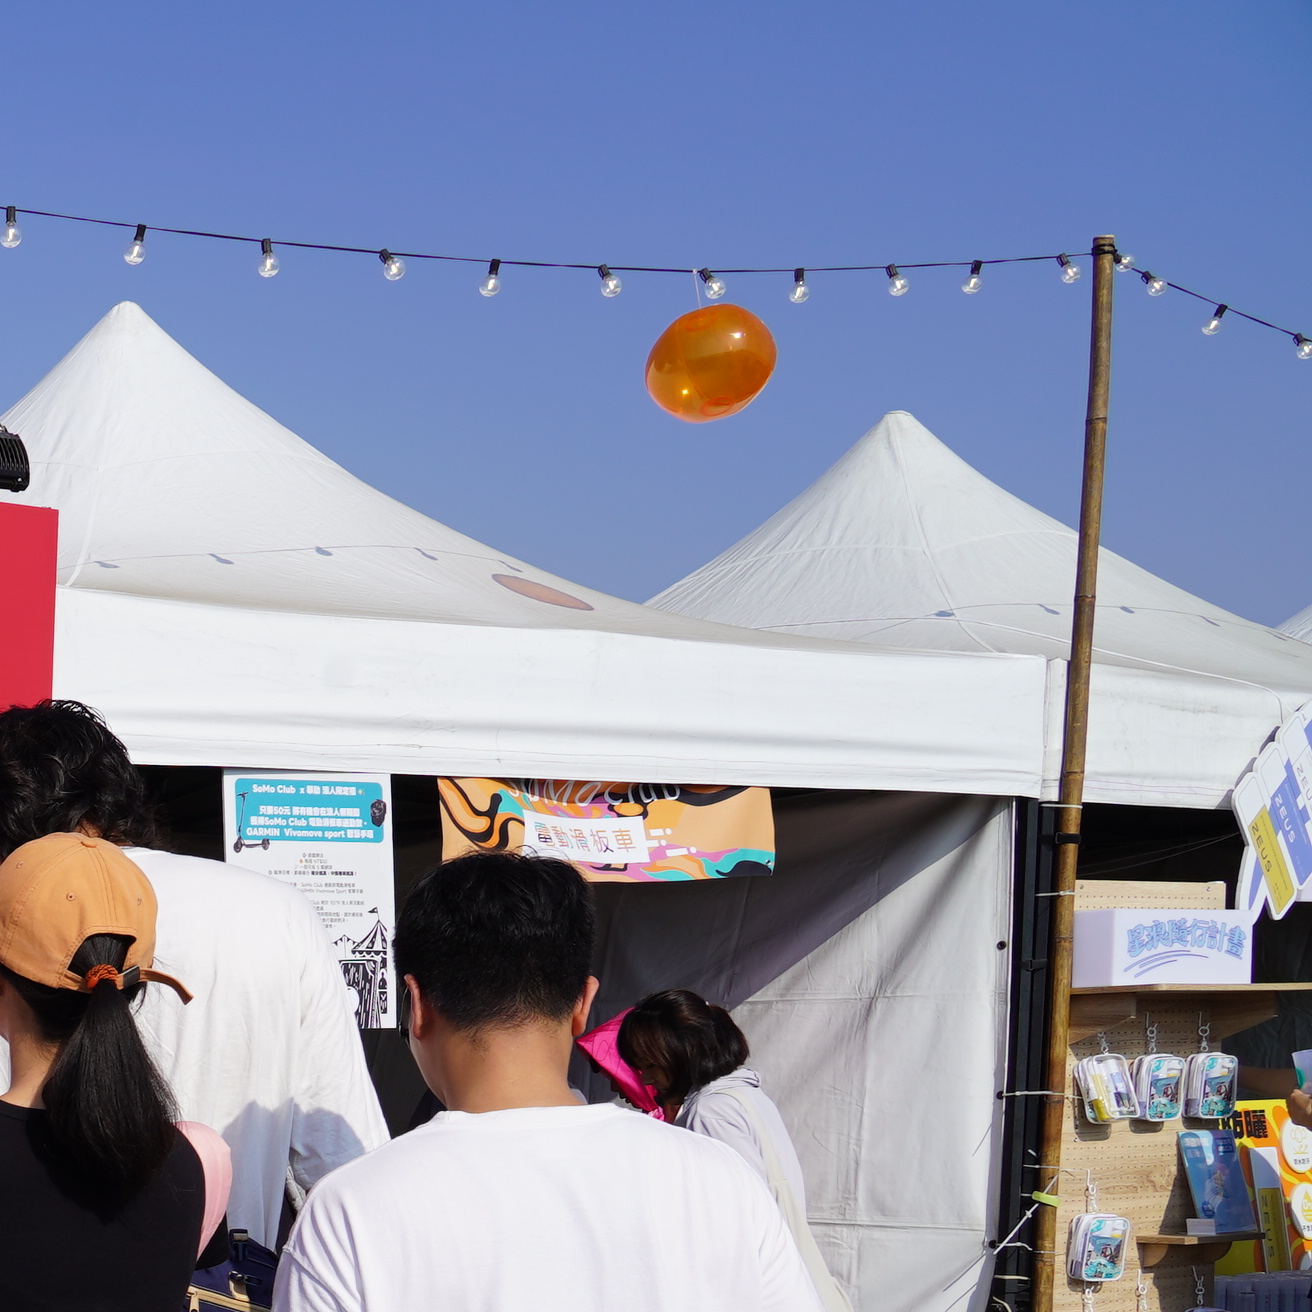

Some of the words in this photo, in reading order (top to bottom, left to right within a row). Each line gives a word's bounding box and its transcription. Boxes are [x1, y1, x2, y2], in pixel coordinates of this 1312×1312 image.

[253, 784, 275, 793] SoMo
[277, 785, 296, 794] Club
[289, 818, 307, 826] Club
[1274, 793, 1295, 843] ZEUS
[246, 828, 280, 836] GARMIN
[285, 828, 322, 838] Vivomove
[325, 830, 345, 839] sport
[534, 820, 637, 853] 電動滑板車
[1251, 822, 1272, 873] ZEUS
